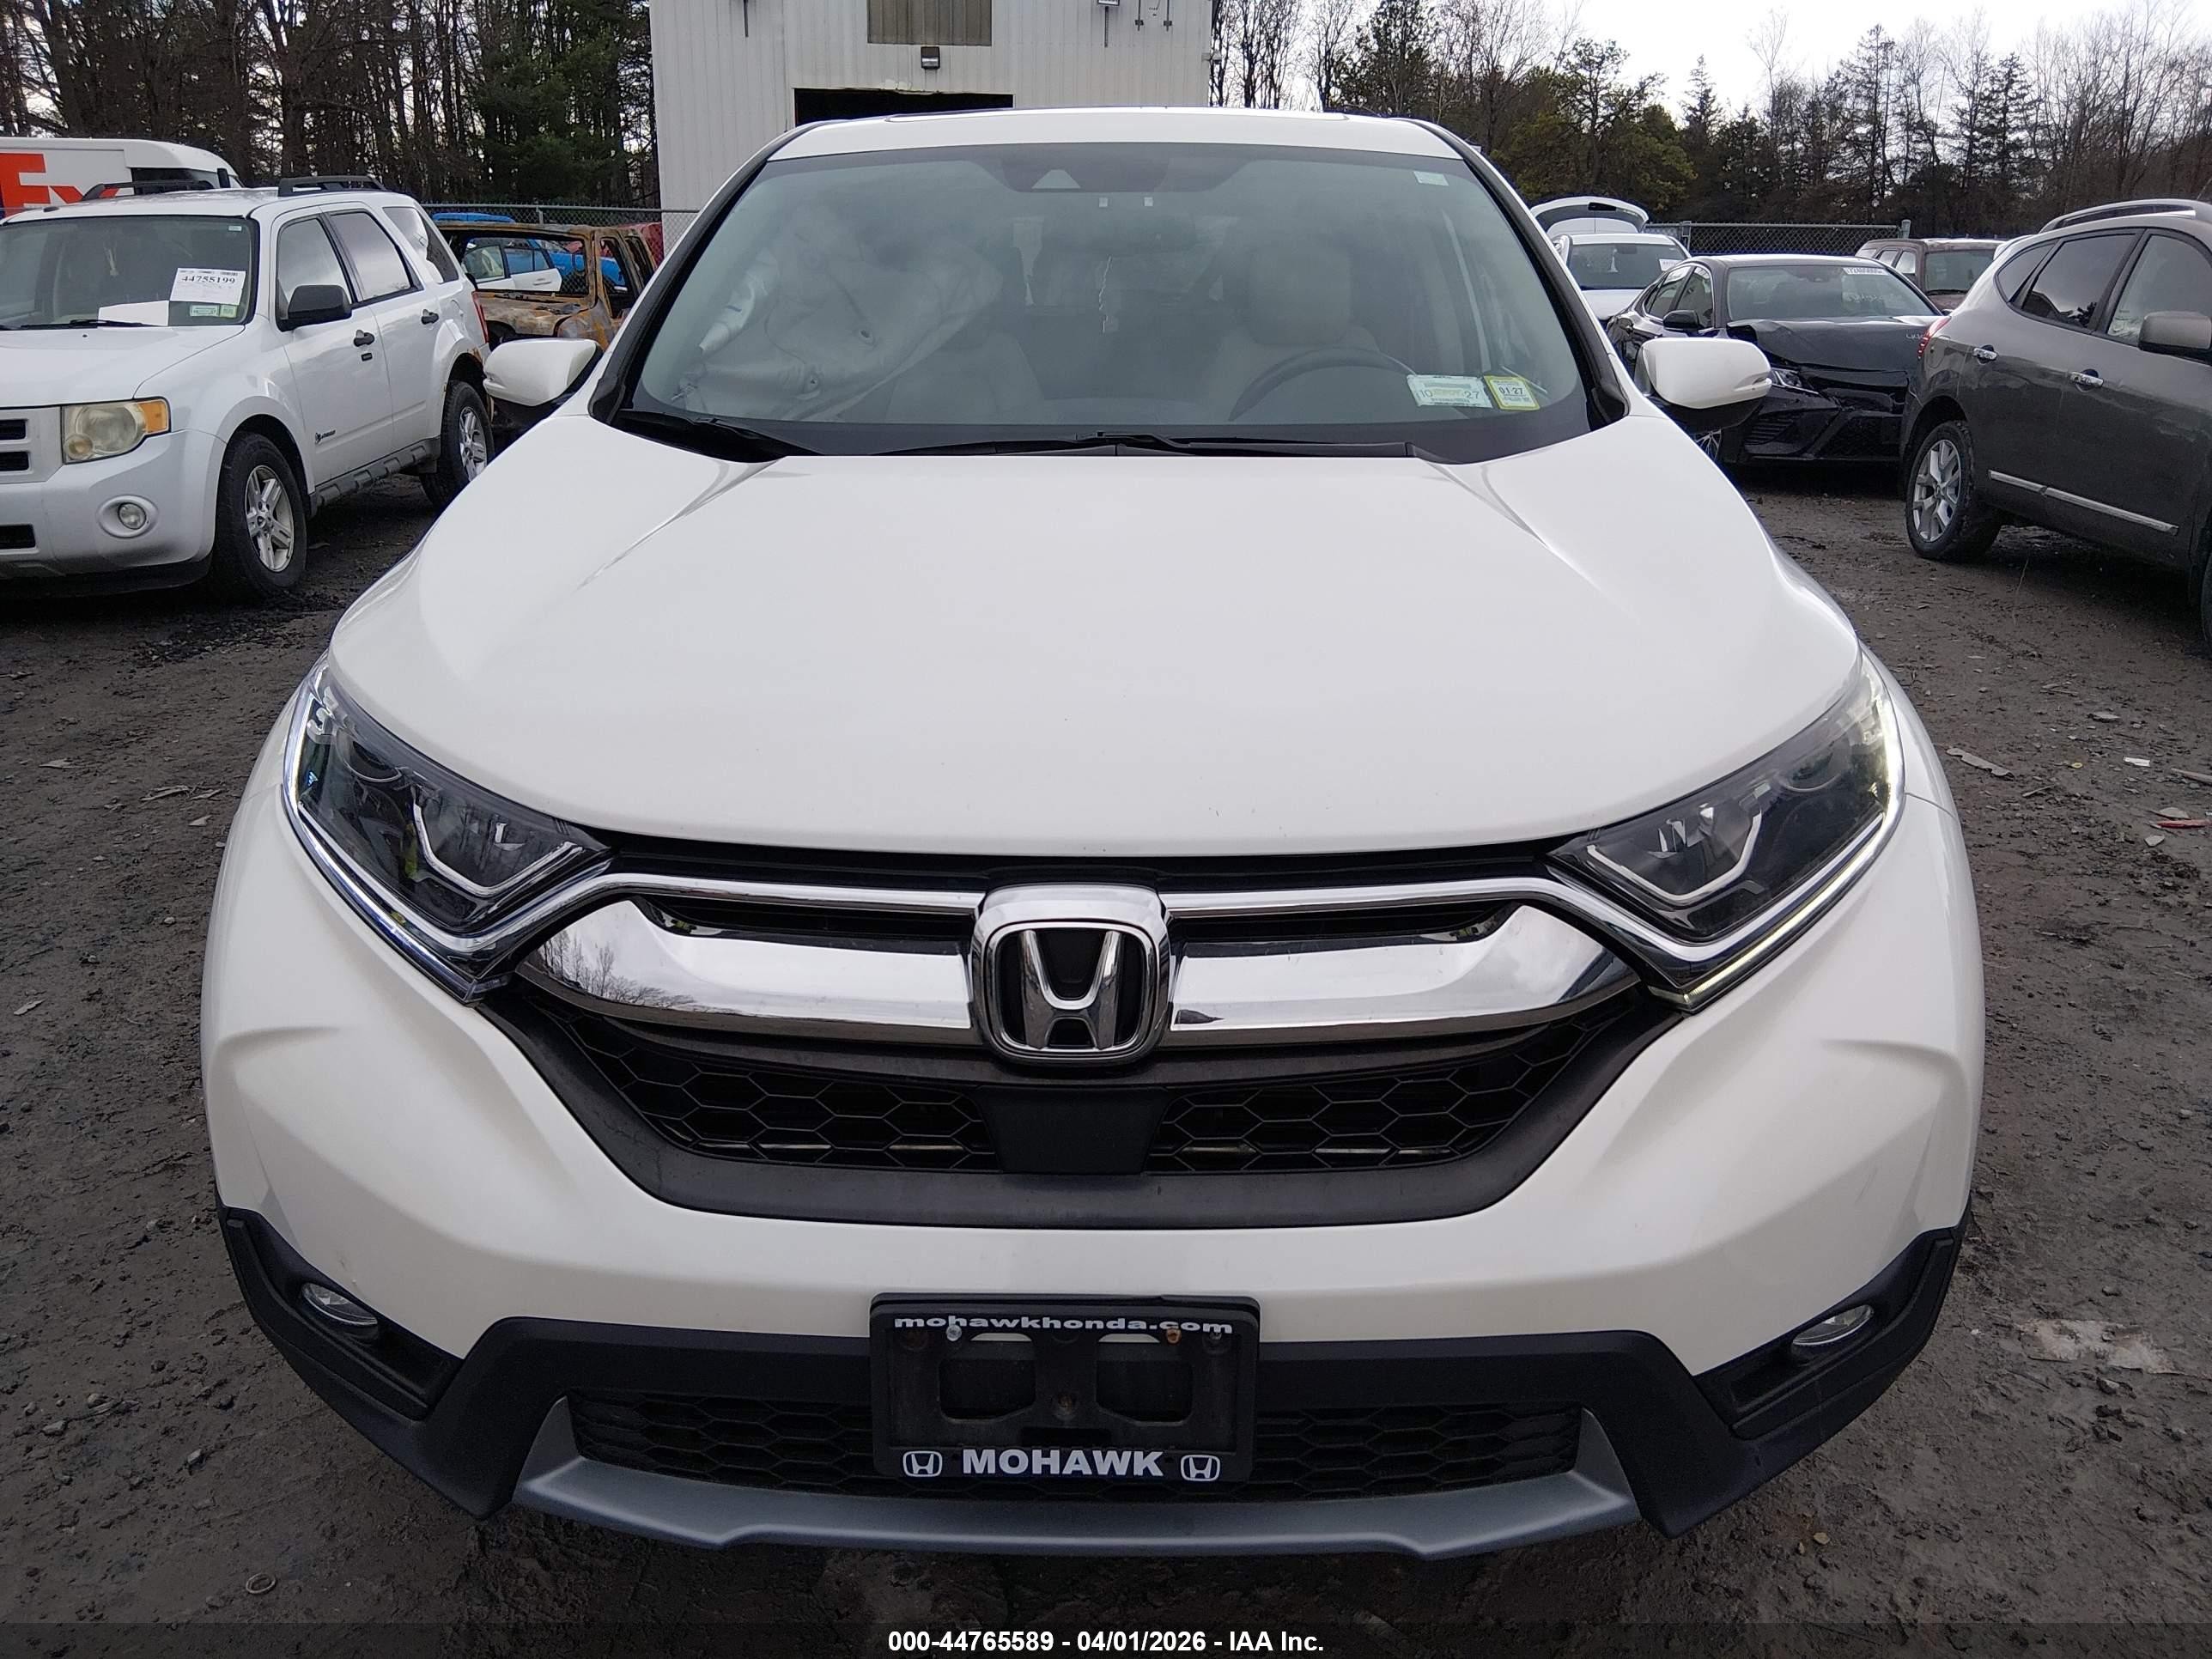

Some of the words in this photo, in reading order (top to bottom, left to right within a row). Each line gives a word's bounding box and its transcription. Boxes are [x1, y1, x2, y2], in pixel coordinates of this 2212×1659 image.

[1464, 390, 1480, 399] 27
[895, 1316, 1233, 1334] mohawkhonda.com
[963, 1449, 1164, 1476] MOHAWK
